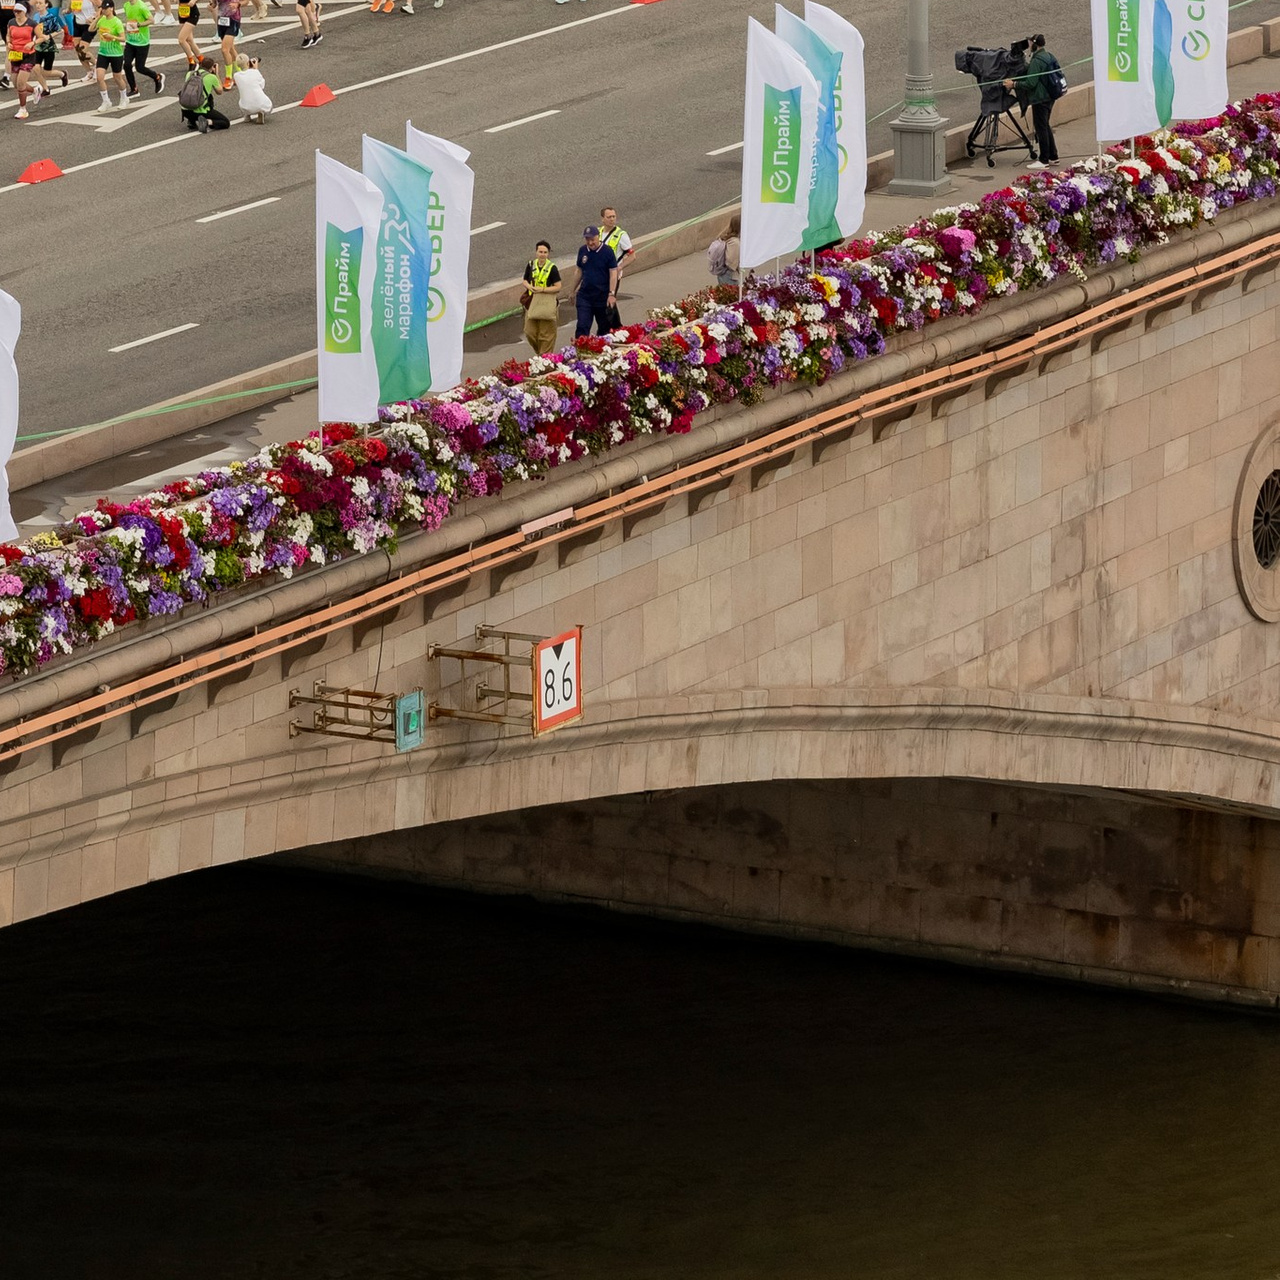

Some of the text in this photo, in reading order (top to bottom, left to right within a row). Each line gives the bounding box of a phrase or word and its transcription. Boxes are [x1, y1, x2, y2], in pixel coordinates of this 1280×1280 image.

[773, 99, 793, 166] Прайм
[333, 241, 351, 314] Прайм
[381, 246, 395, 328] зелёный
[398, 255, 415, 340] марафон
[544, 660, 574, 710] 8.6
